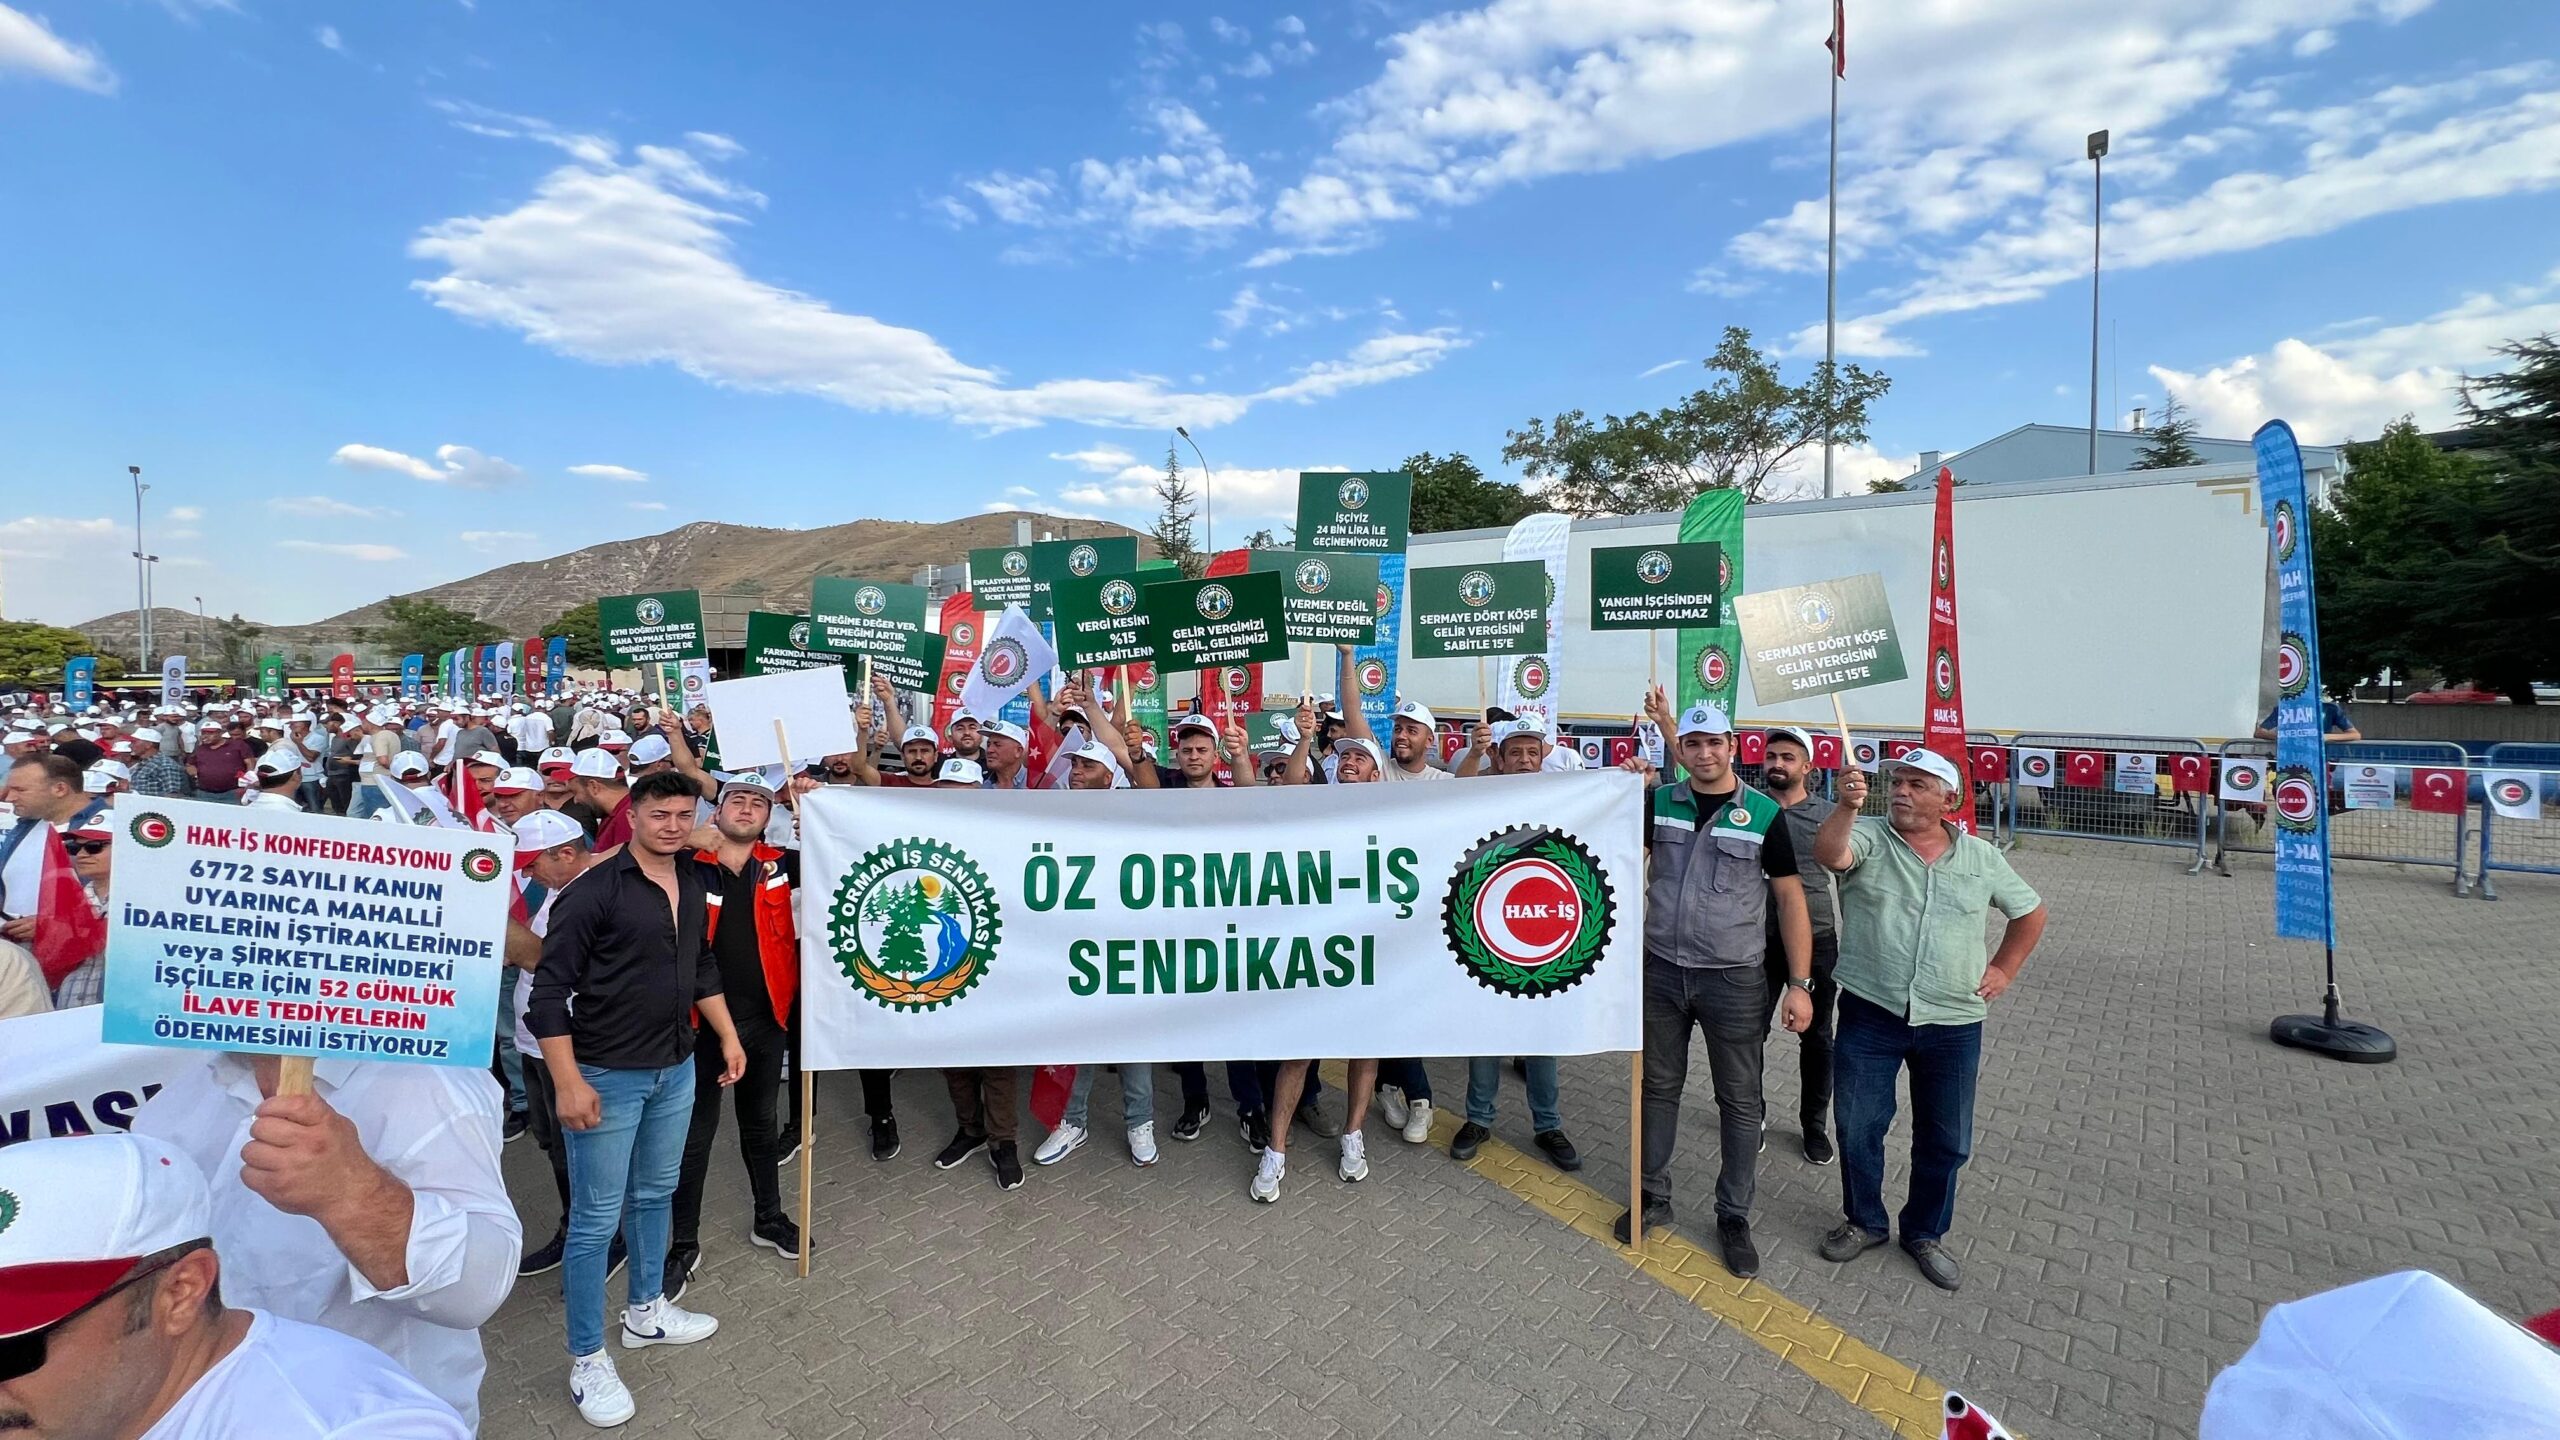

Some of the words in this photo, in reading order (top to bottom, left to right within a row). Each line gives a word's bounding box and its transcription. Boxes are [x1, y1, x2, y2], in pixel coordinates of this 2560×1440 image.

[1336, 512, 1368, 524] İŞÇİYİZ
[1316, 526, 1328, 534] 24
[1330, 524, 1346, 535] BİN
[1348, 524, 1370, 535] LİRA
[1372, 524, 1386, 535] İLE
[1312, 536, 1388, 548] GEÇİNEMİYORUZ
[980, 586, 1005, 594] SADECE
[1290, 598, 1334, 610] VERMEK
[1337, 598, 1368, 612] DEĞİL
[1599, 596, 1642, 608] YANGIN
[1646, 593, 1712, 608] İŞÇİSİNDEN
[1294, 612, 1326, 624] VERGİ
[1328, 614, 1374, 626] VERMEK
[1420, 612, 1471, 626] SERMAYE
[1474, 610, 1504, 622] DÖRT
[1508, 608, 1538, 622] KÖŞE
[1602, 610, 1663, 621] TASARRUF
[1666, 608, 1708, 619] OLMAZ
[610, 628, 628, 636] AYNI
[629, 625, 665, 636] DOĞRUYU
[666, 624, 679, 632] BİR
[817, 614, 861, 626] EMEĞİME
[862, 617, 895, 629] DEĞER
[896, 622, 918, 632] VER,
[1076, 618, 1110, 632] VERGİ
[1172, 626, 1205, 640] GELİR
[1207, 618, 1264, 636] VERGİMİZİ
[1434, 624, 1465, 638] GELİR
[1468, 622, 1524, 636] VERGİSİNİ
[610, 637, 632, 645] DAHA
[633, 635, 664, 644] YAPMAK
[665, 632, 696, 641] İSTEMEZ
[827, 626, 874, 638] EKMEĞİMİ
[876, 632, 907, 642] ARTIR,
[1110, 631, 1136, 646] %15
[1316, 626, 1360, 639] EDİYOR!
[649, 642, 681, 652] İŞÇİLERE
[682, 641, 693, 649] DE
[828, 636, 868, 648] VERGİMİ
[870, 641, 906, 652] DÜŞÜR!
[1172, 637, 1208, 653] DEĞİL,
[1210, 630, 1268, 650] GELİRİMİZİ
[1444, 638, 1490, 651] SABİTLE
[1492, 638, 1514, 649] 15'E
[1757, 642, 1815, 662] SERMAYE
[1818, 635, 1852, 652] DÖRT
[1854, 629, 1888, 646] KÖŞE
[632, 653, 654, 662] İLAVE
[654, 651, 679, 660] ÜCRET
[764, 648, 806, 658] FARKINDA
[1076, 652, 1094, 664] İLE
[1194, 649, 1250, 664] ARTTIRIN!
[1776, 658, 1813, 676] GELİR
[1816, 645, 1878, 669] VERGİSİNİ
[756, 656, 800, 668] MAAŞIMIZ,
[892, 675, 923, 688] OLMALI
[1791, 671, 1844, 690] SABİTLE
[1846, 666, 1870, 681] 15'E
[1934, 708, 1958, 726] HAK-İŞ
[186, 824, 259, 852] HAK-İŞ
[264, 834, 452, 872] KONFEDERASYONU
[902, 848, 922, 867] İŞ
[190, 860, 254, 884] 6772
[262, 867, 346, 893] SAYILI
[354, 876, 443, 902] KANUN
[841, 854, 897, 916] ORMAN
[1023, 842, 1096, 912] ÖZ
[1119, 834, 1420, 920] ORMAN-İŞ
[185, 886, 319, 918] UYARINCA
[327, 900, 443, 928] MAHALLİ
[928, 852, 990, 950] SENDİKASI
[1504, 899, 1576, 921] HAK-İŞ
[124, 903, 280, 940] İDARELERİN
[287, 918, 493, 960] İŞTİRAKLERİNDE
[840, 924, 858, 953] ÖZ
[164, 942, 224, 966] veya
[231, 942, 454, 981] ŞİRKETLERİNDEKİ
[1067, 923, 1375, 996] SENDİKASI
[154, 960, 254, 992] İŞÇİLER
[261, 970, 311, 996] İÇİN
[319, 979, 349, 999] 52
[356, 980, 456, 1008] GÜNLÜK
[183, 990, 260, 1018] İLAVE
[266, 1000, 426, 1031] TEDİYELERİN
[154, 1014, 312, 1048] ÖDENMESİNİ
[318, 1026, 448, 1058] İSTİYORUZ
